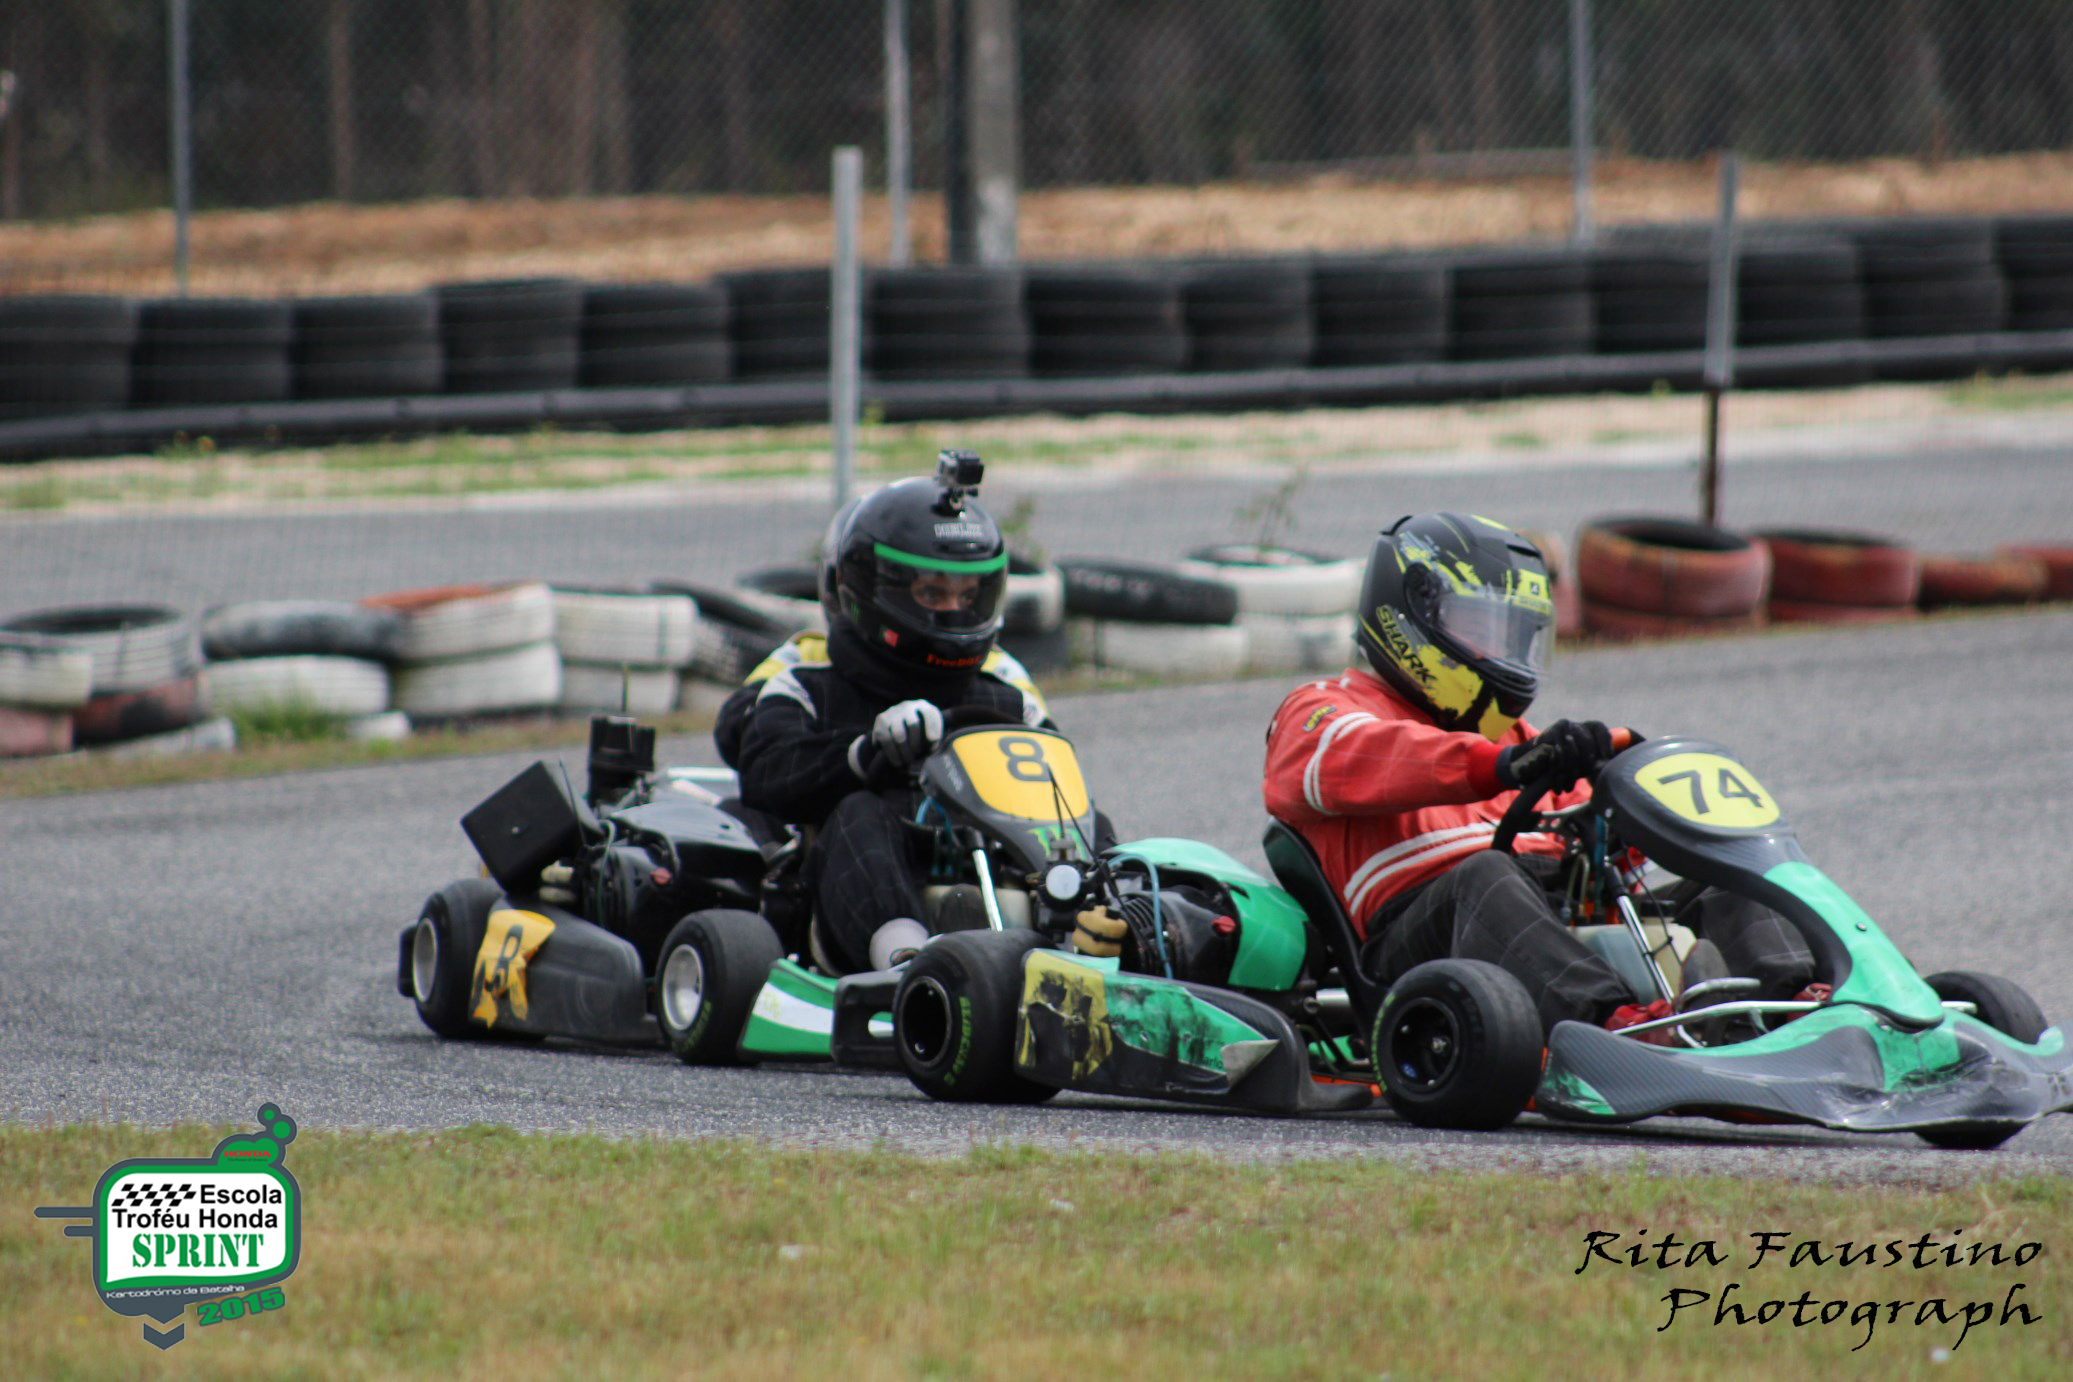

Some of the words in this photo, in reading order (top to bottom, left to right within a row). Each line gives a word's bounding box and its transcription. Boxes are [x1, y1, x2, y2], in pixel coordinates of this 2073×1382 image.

[1375, 604, 1439, 685] SHARK
[998, 735, 1052, 783] 8
[1657, 767, 1765, 816] 74
